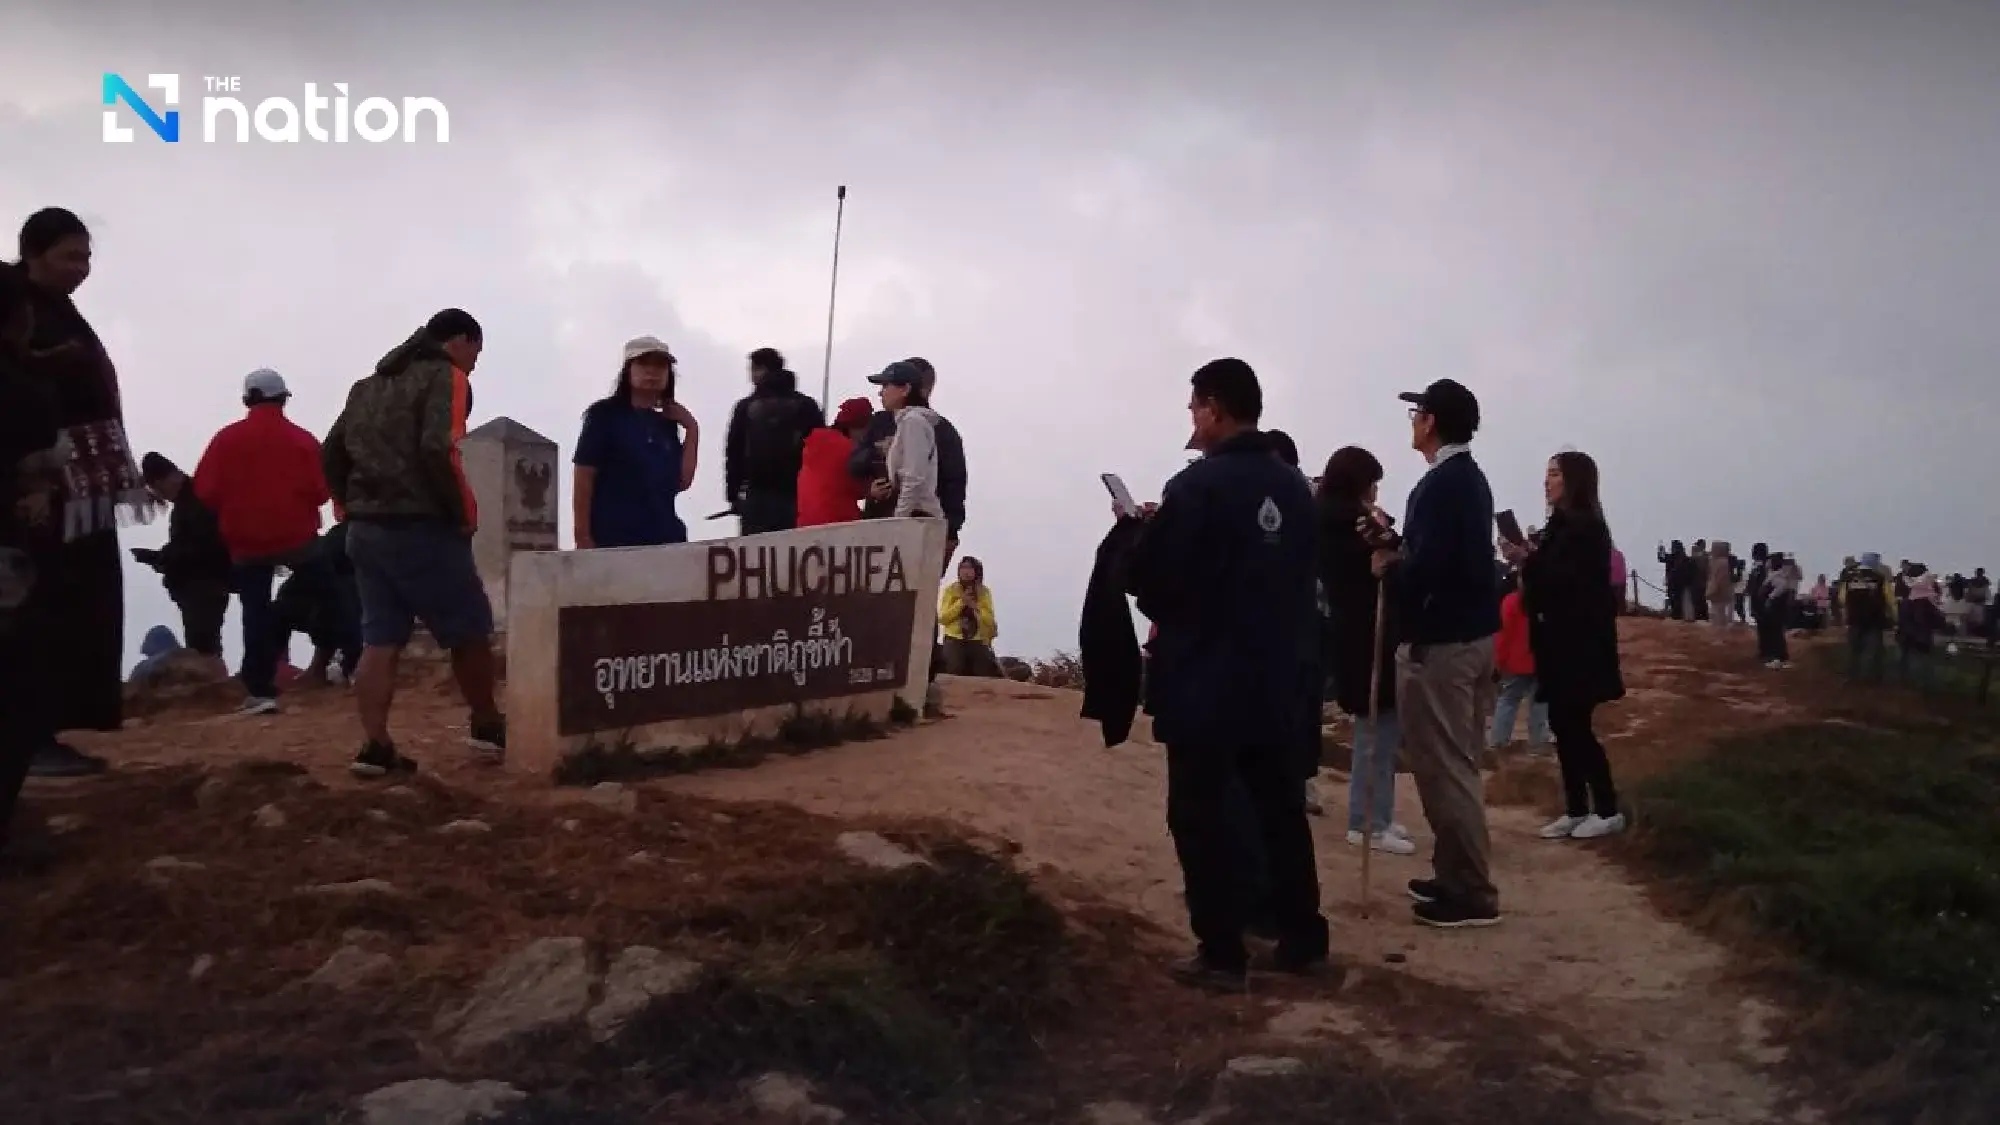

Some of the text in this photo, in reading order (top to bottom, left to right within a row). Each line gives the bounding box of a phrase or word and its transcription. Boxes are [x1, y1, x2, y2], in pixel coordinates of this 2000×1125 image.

[707, 545, 907, 601] PHUCHIFA
[594, 607, 852, 709] อุทยานแห่งชาติภูชี้ฟ้า
